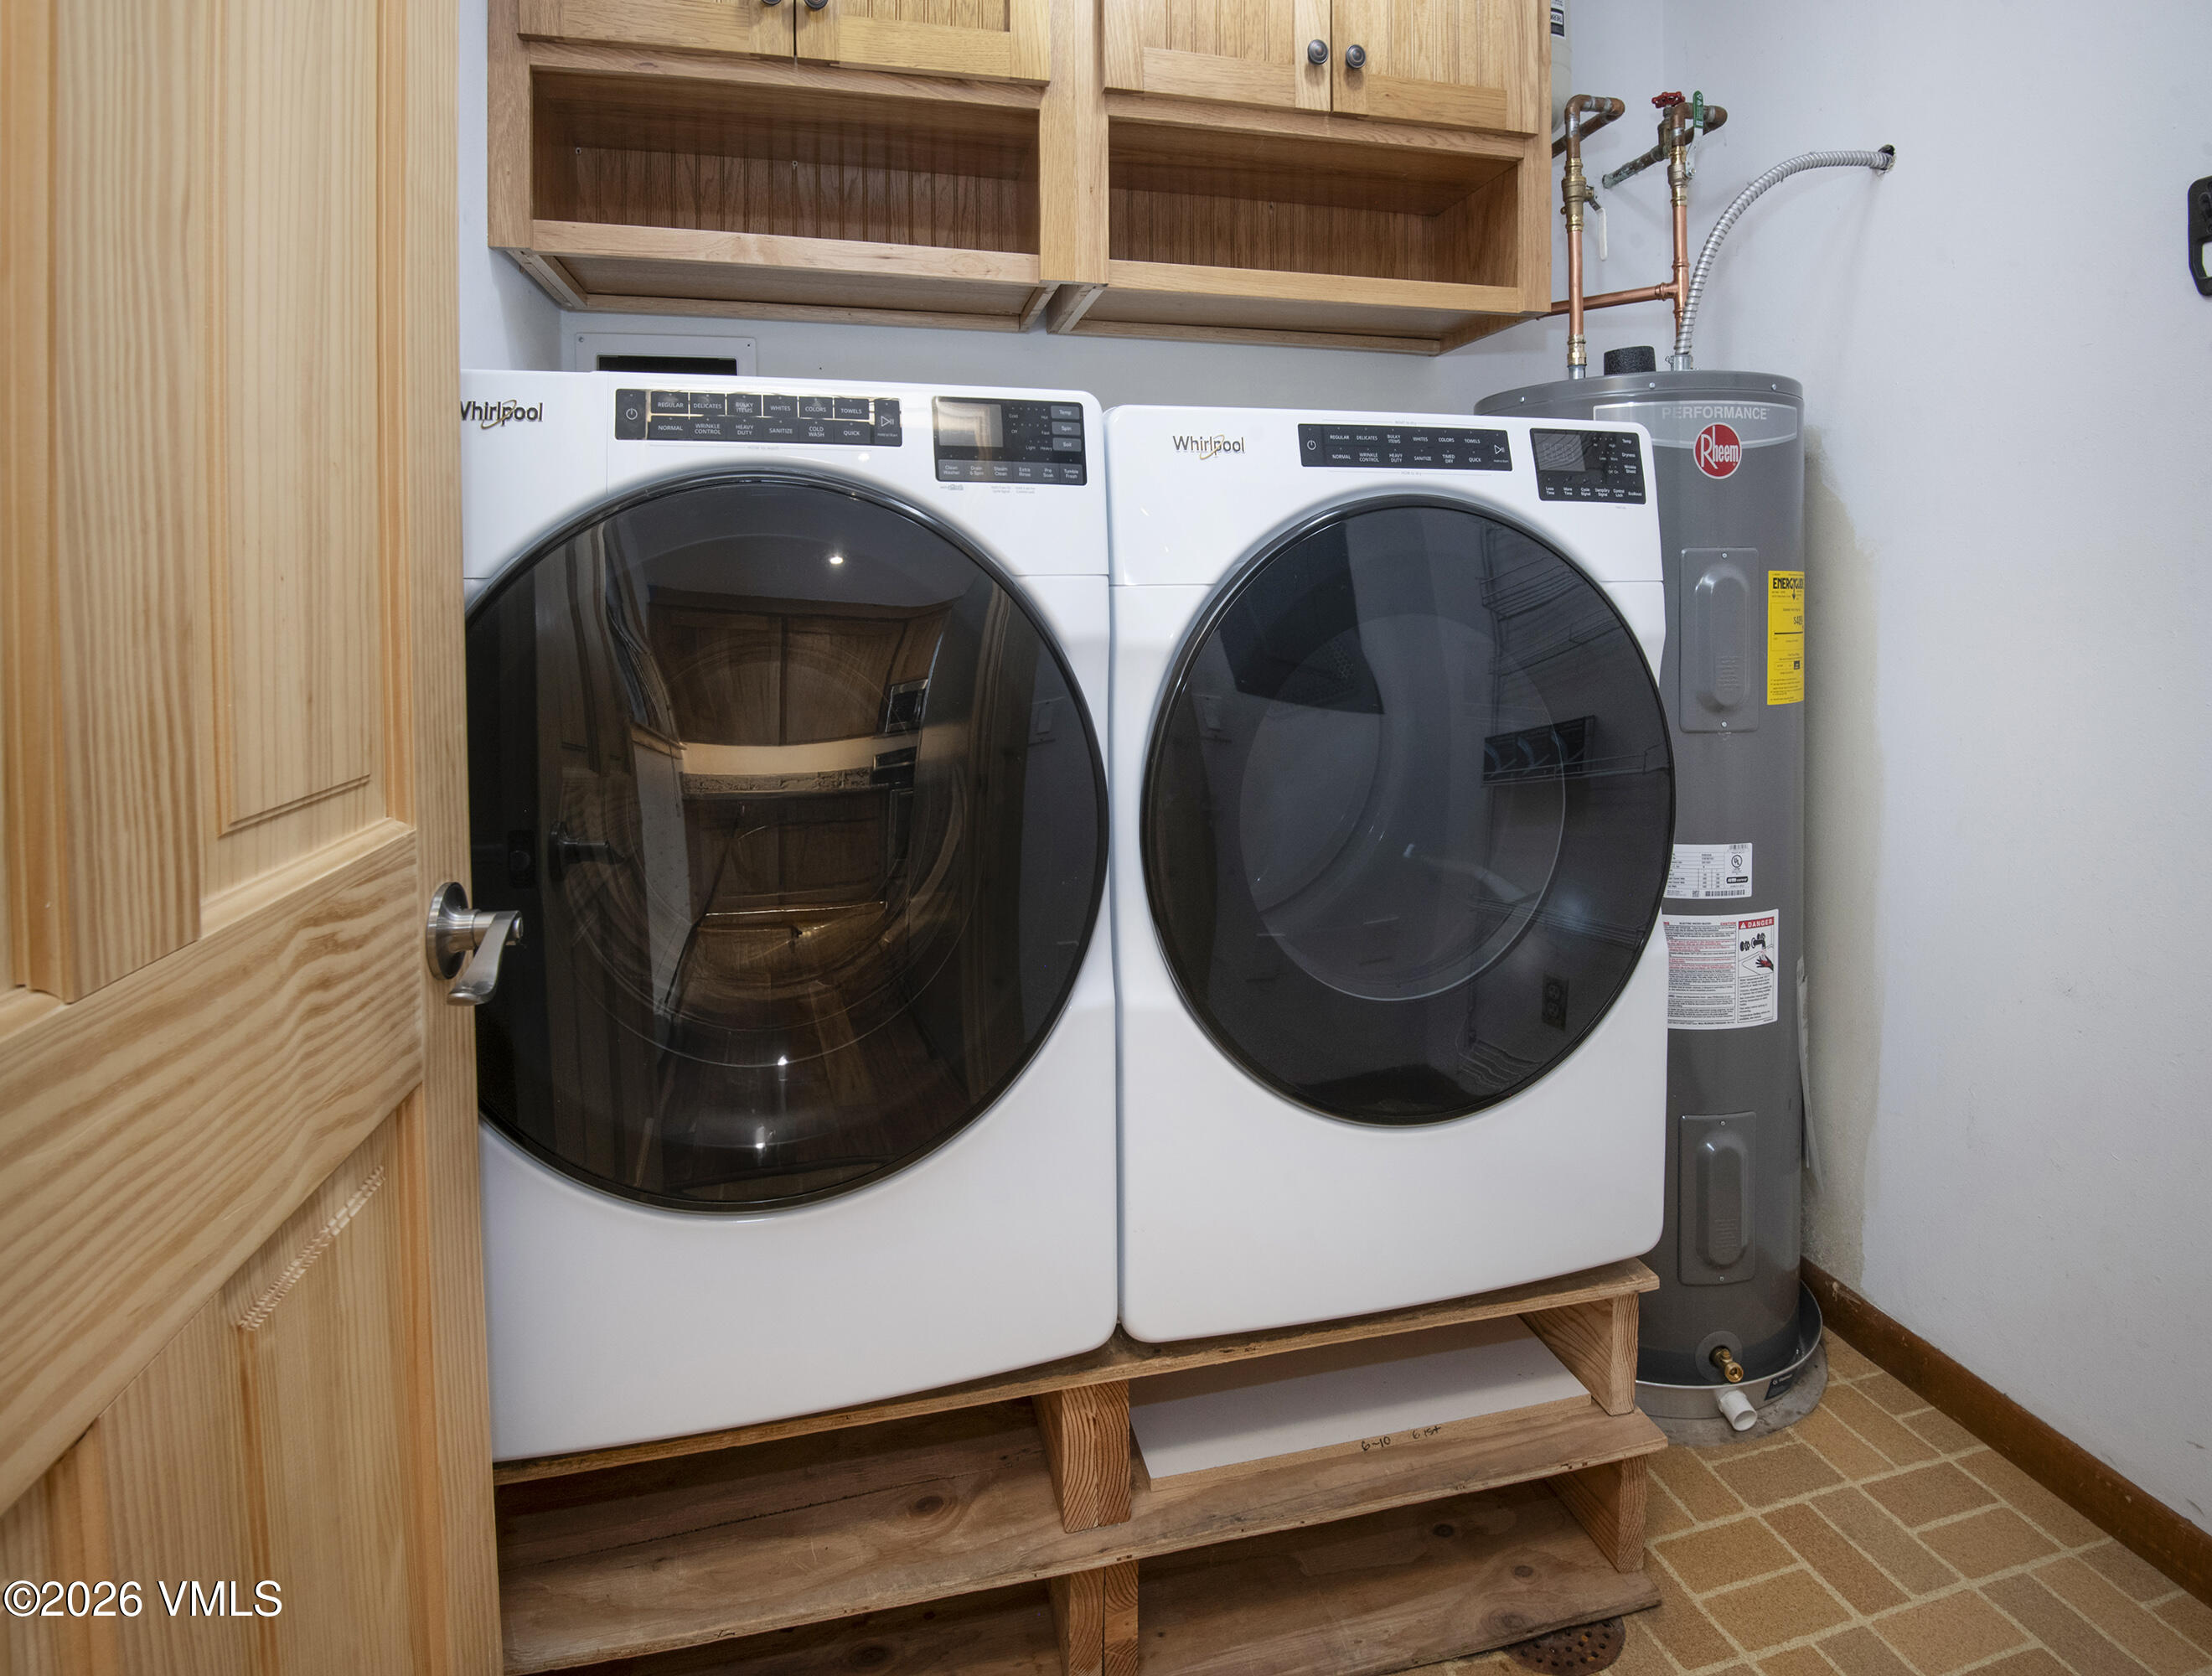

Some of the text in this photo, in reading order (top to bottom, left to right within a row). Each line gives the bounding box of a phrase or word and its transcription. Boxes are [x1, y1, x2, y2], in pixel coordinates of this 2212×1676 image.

[1662, 406, 1768, 420] PERFORMANCE
[1172, 434, 1246, 459] Whirlpool
[1700, 426, 1739, 469] Rheem
[1747, 918, 1774, 929] DANGER
